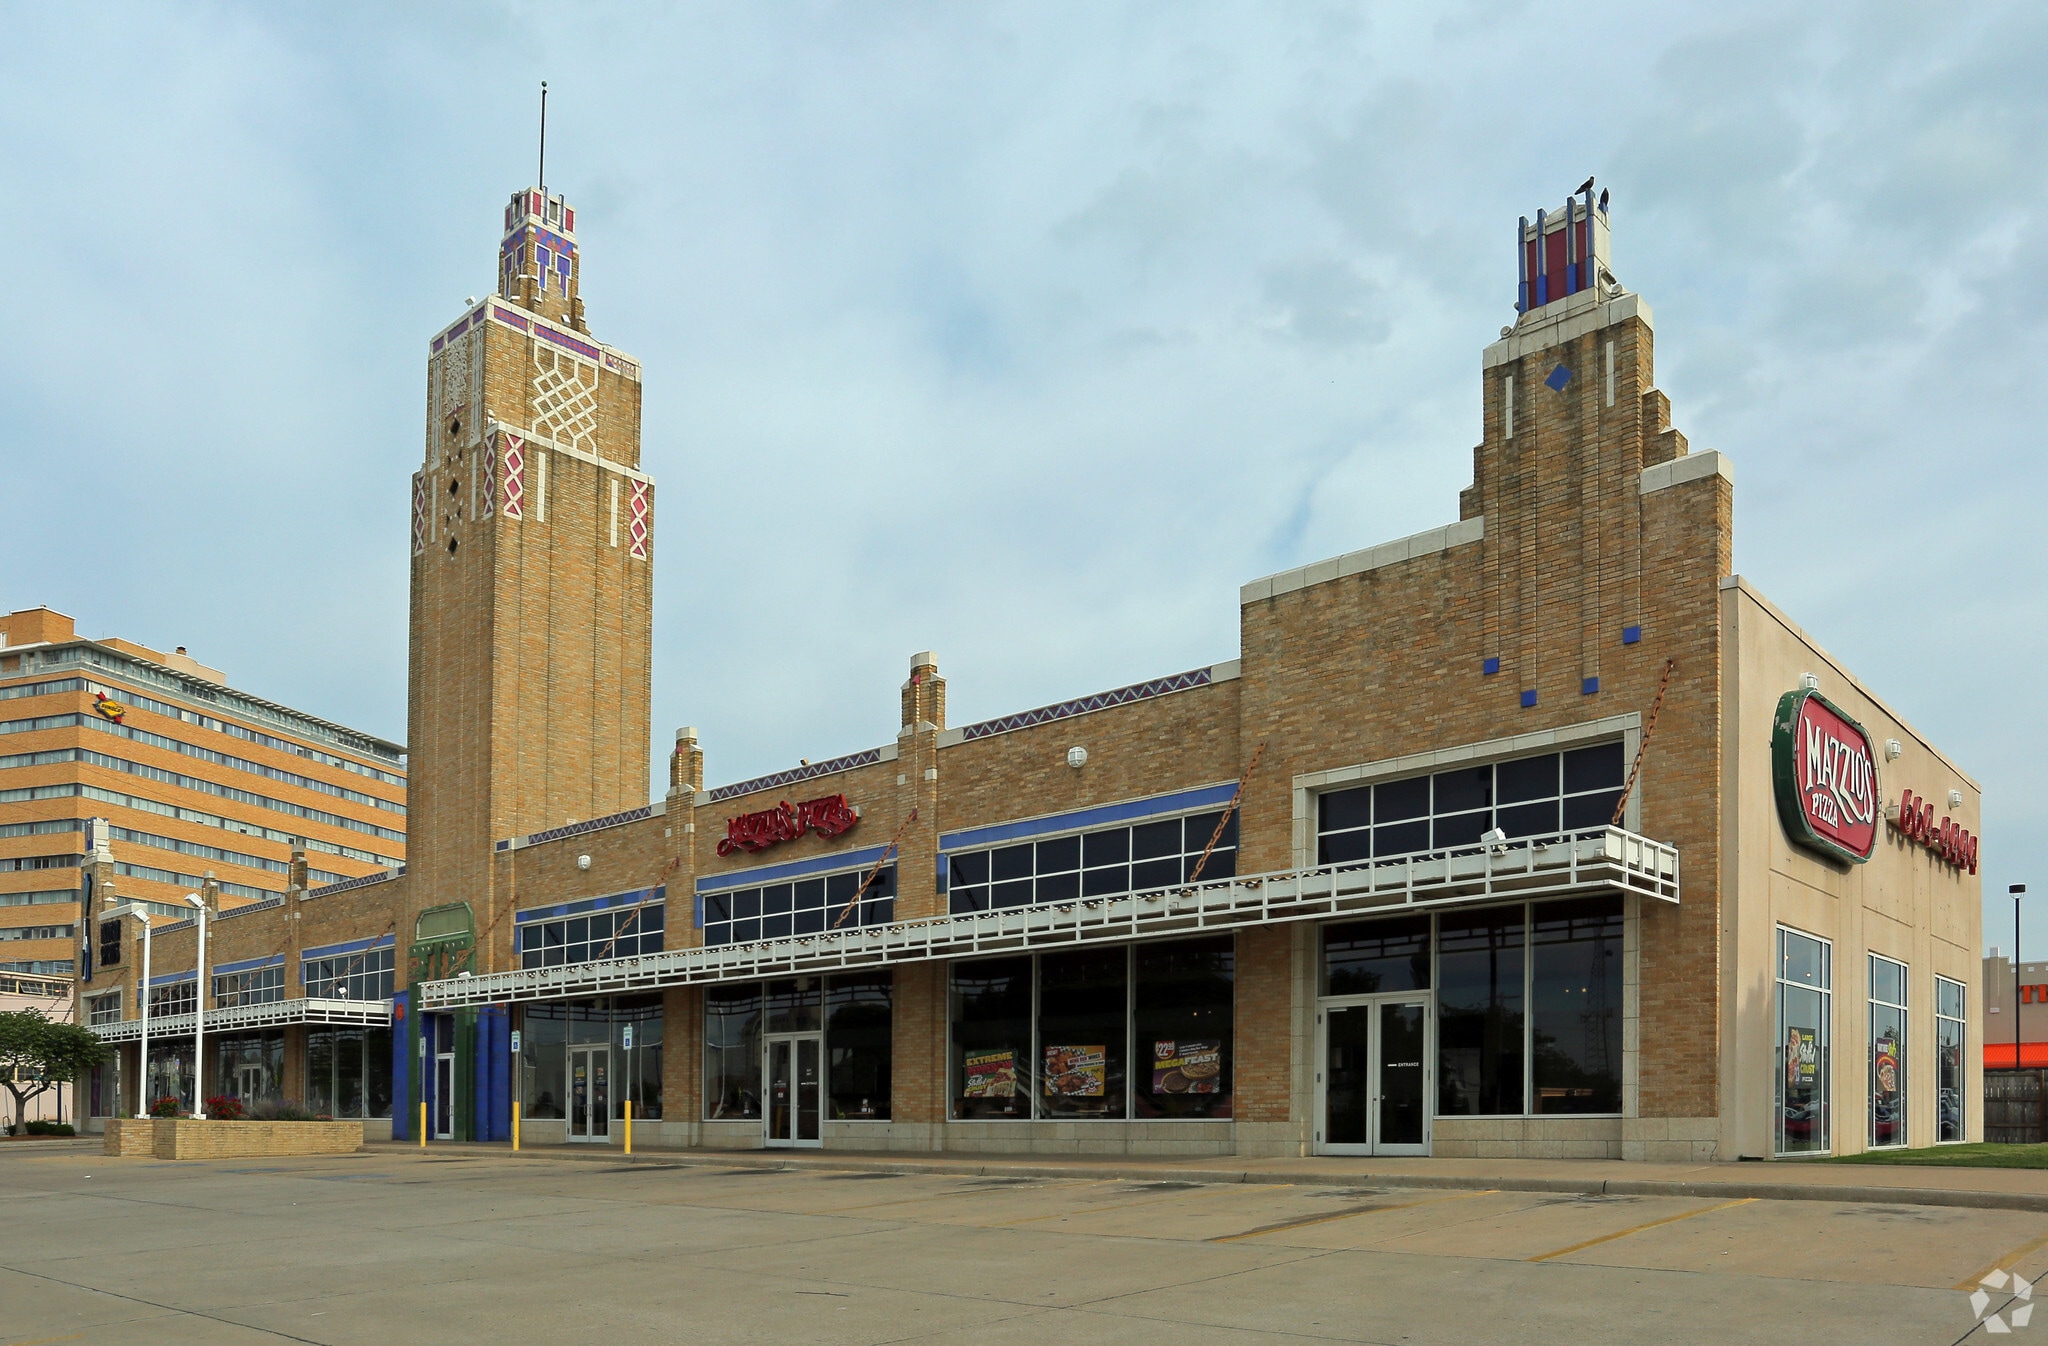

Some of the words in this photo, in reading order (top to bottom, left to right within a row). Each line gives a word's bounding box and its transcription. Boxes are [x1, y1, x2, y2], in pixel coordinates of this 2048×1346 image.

[1804, 716, 1874, 824] MAZZIO'S
[1811, 792, 1839, 829] PIZZA
[1900, 789, 1978, 876] 664-4444
[966, 1051, 1013, 1067] EXTREME
